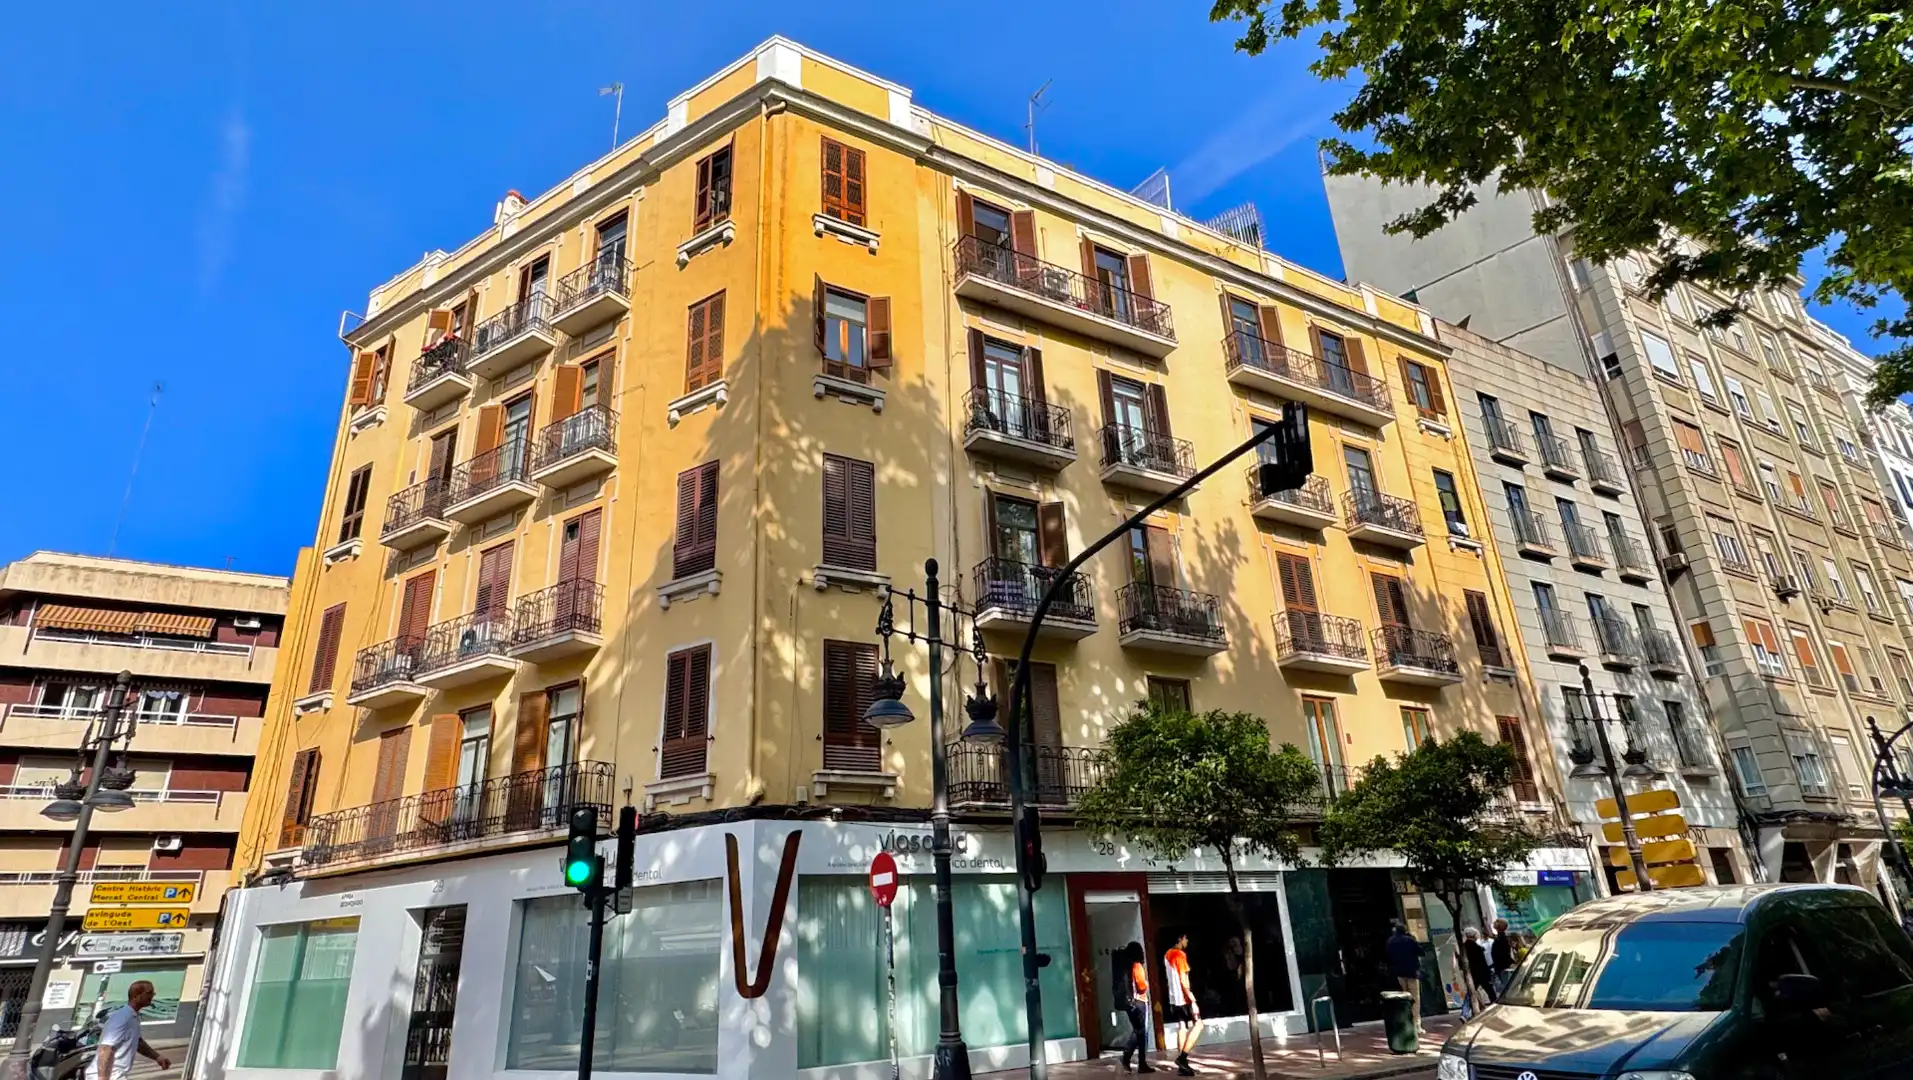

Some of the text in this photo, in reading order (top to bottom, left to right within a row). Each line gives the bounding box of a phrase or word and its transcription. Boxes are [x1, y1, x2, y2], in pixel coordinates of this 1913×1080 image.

[1098, 842, 1116, 856] 28
[969, 856, 1004, 869] dental
[89, 910, 132, 918] avinguda
